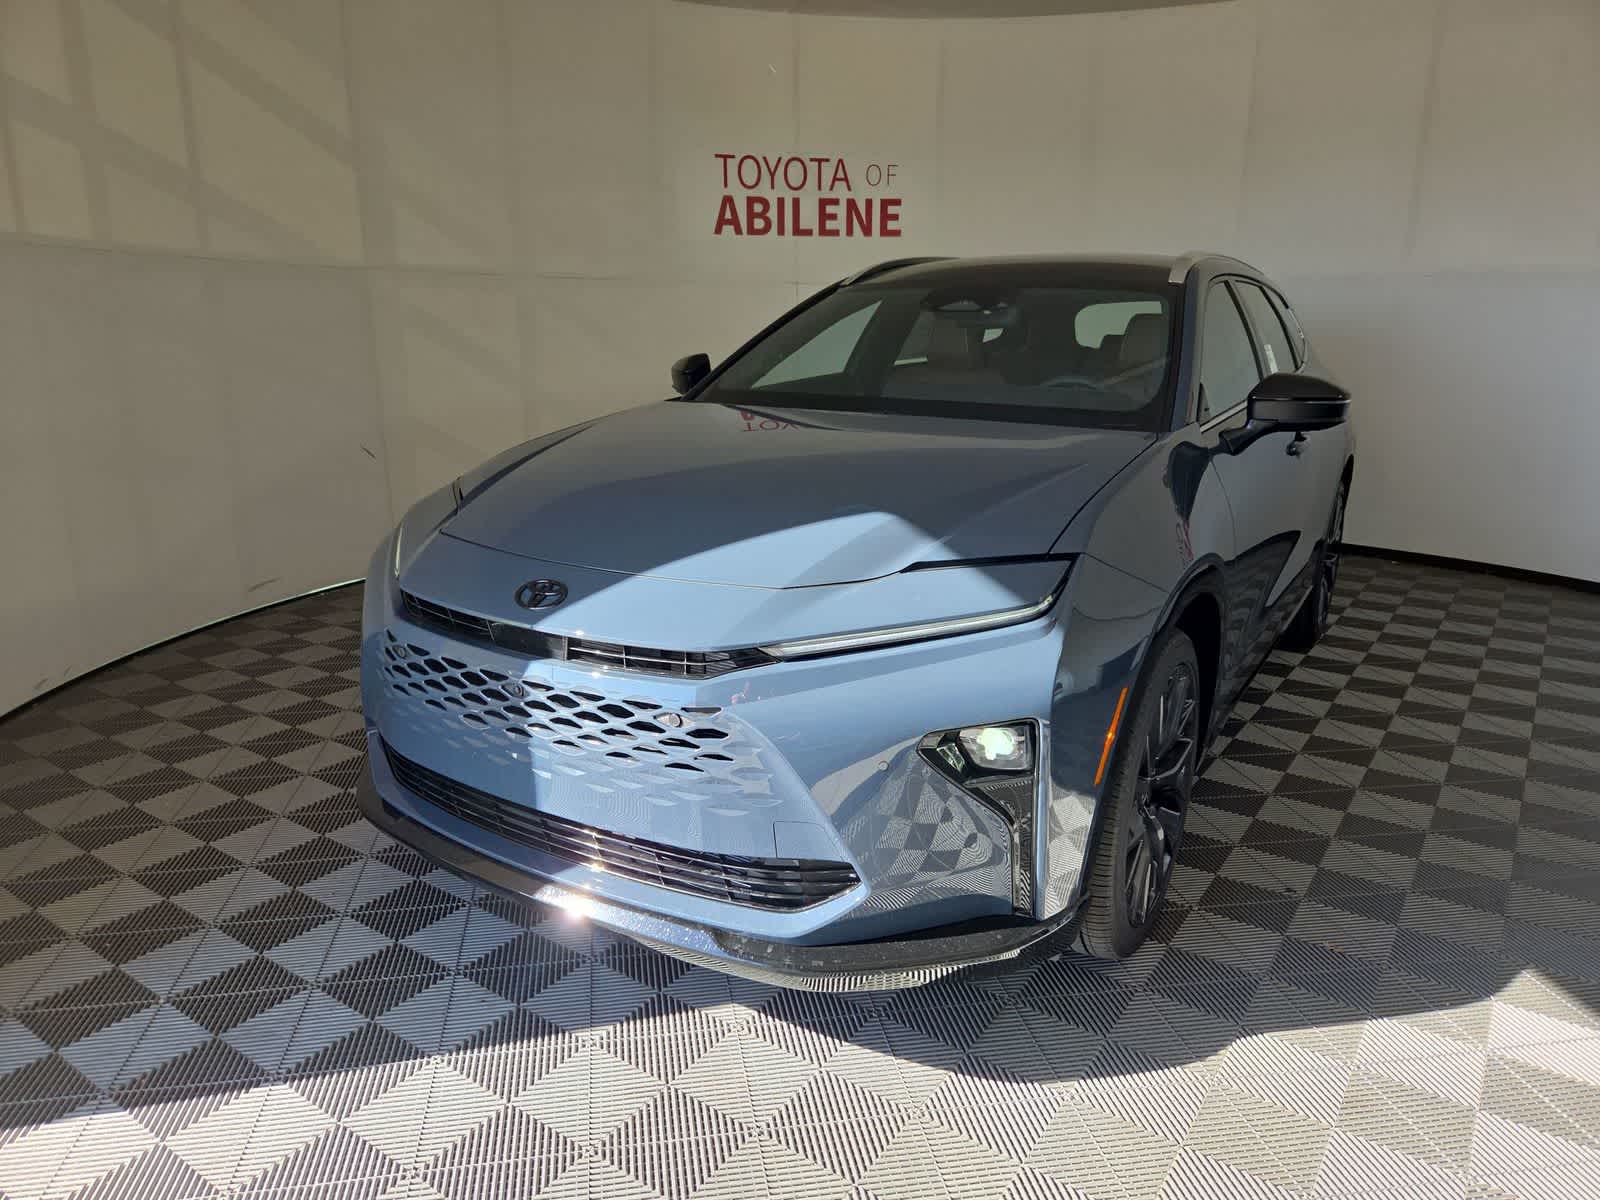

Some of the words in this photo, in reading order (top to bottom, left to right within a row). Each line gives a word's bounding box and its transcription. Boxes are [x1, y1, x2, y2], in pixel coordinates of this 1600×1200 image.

[714, 153, 852, 191] TOYOTA
[865, 164, 898, 187] OF
[713, 195, 902, 237] ABILENE
